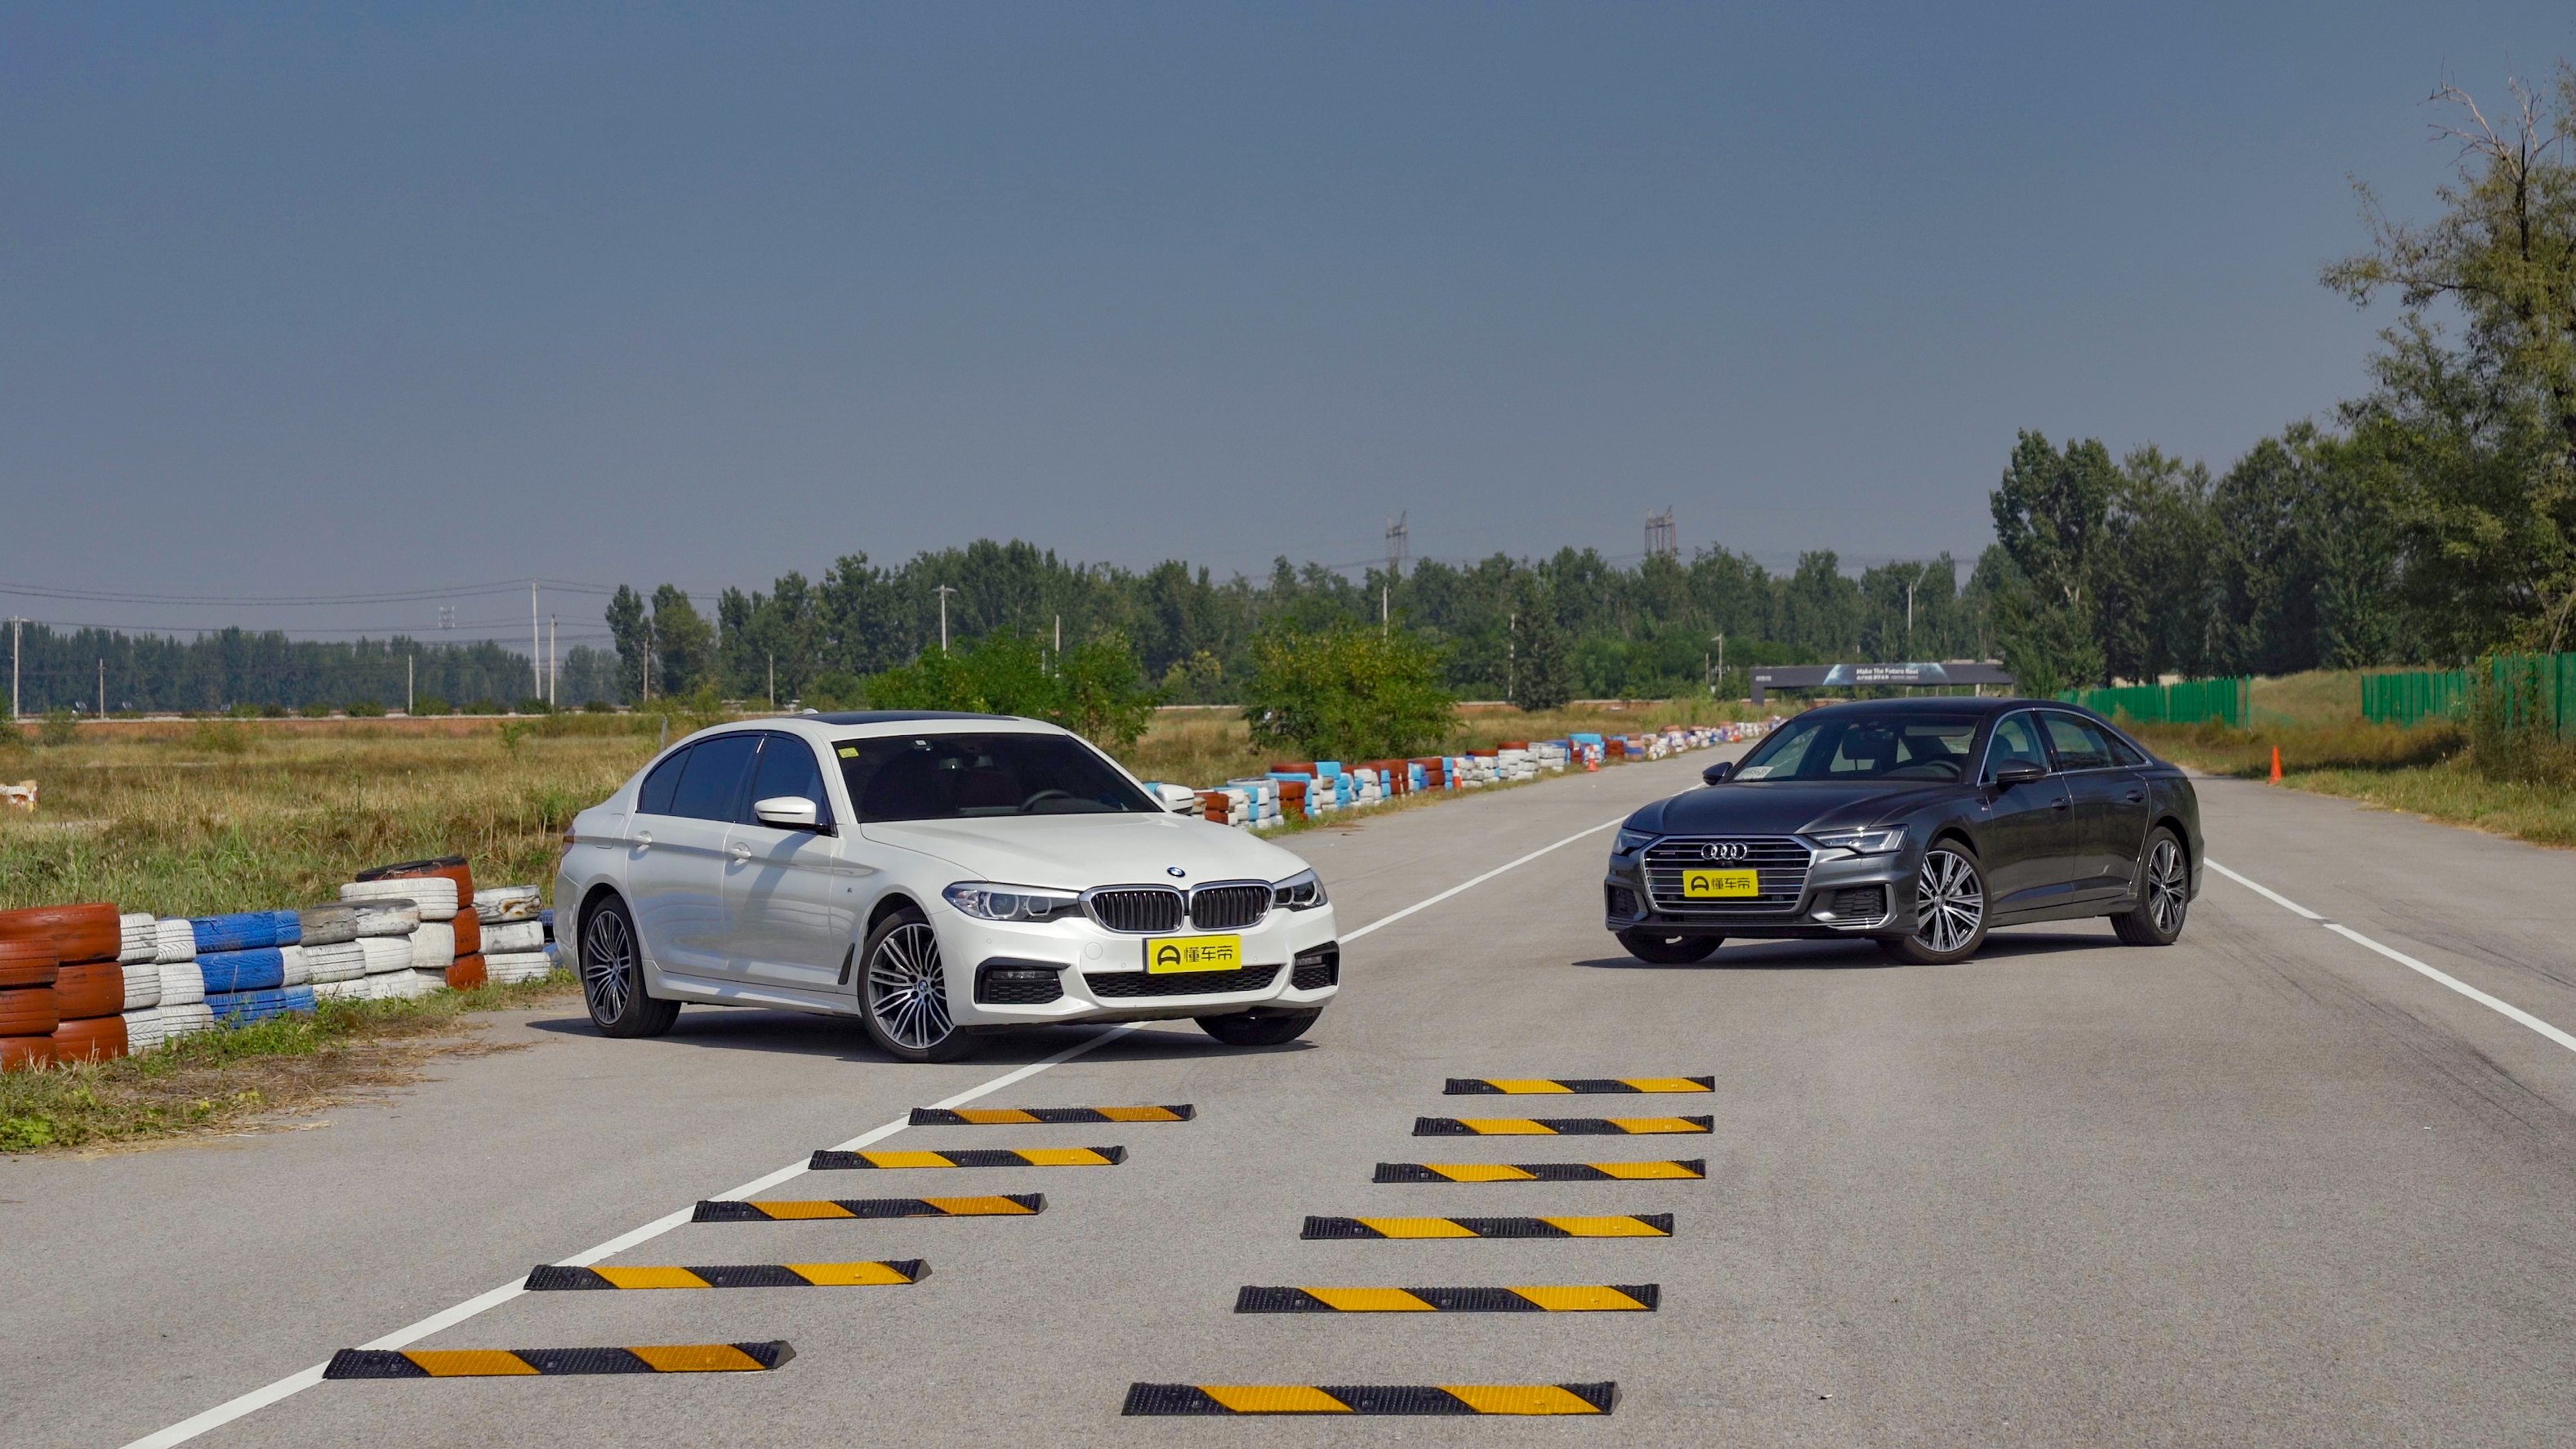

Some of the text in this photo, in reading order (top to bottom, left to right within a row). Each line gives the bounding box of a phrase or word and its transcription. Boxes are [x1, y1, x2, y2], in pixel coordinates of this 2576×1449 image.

[1711, 877, 1750, 889] 懂车帝
[1184, 945, 1233, 962] 懂车帝
